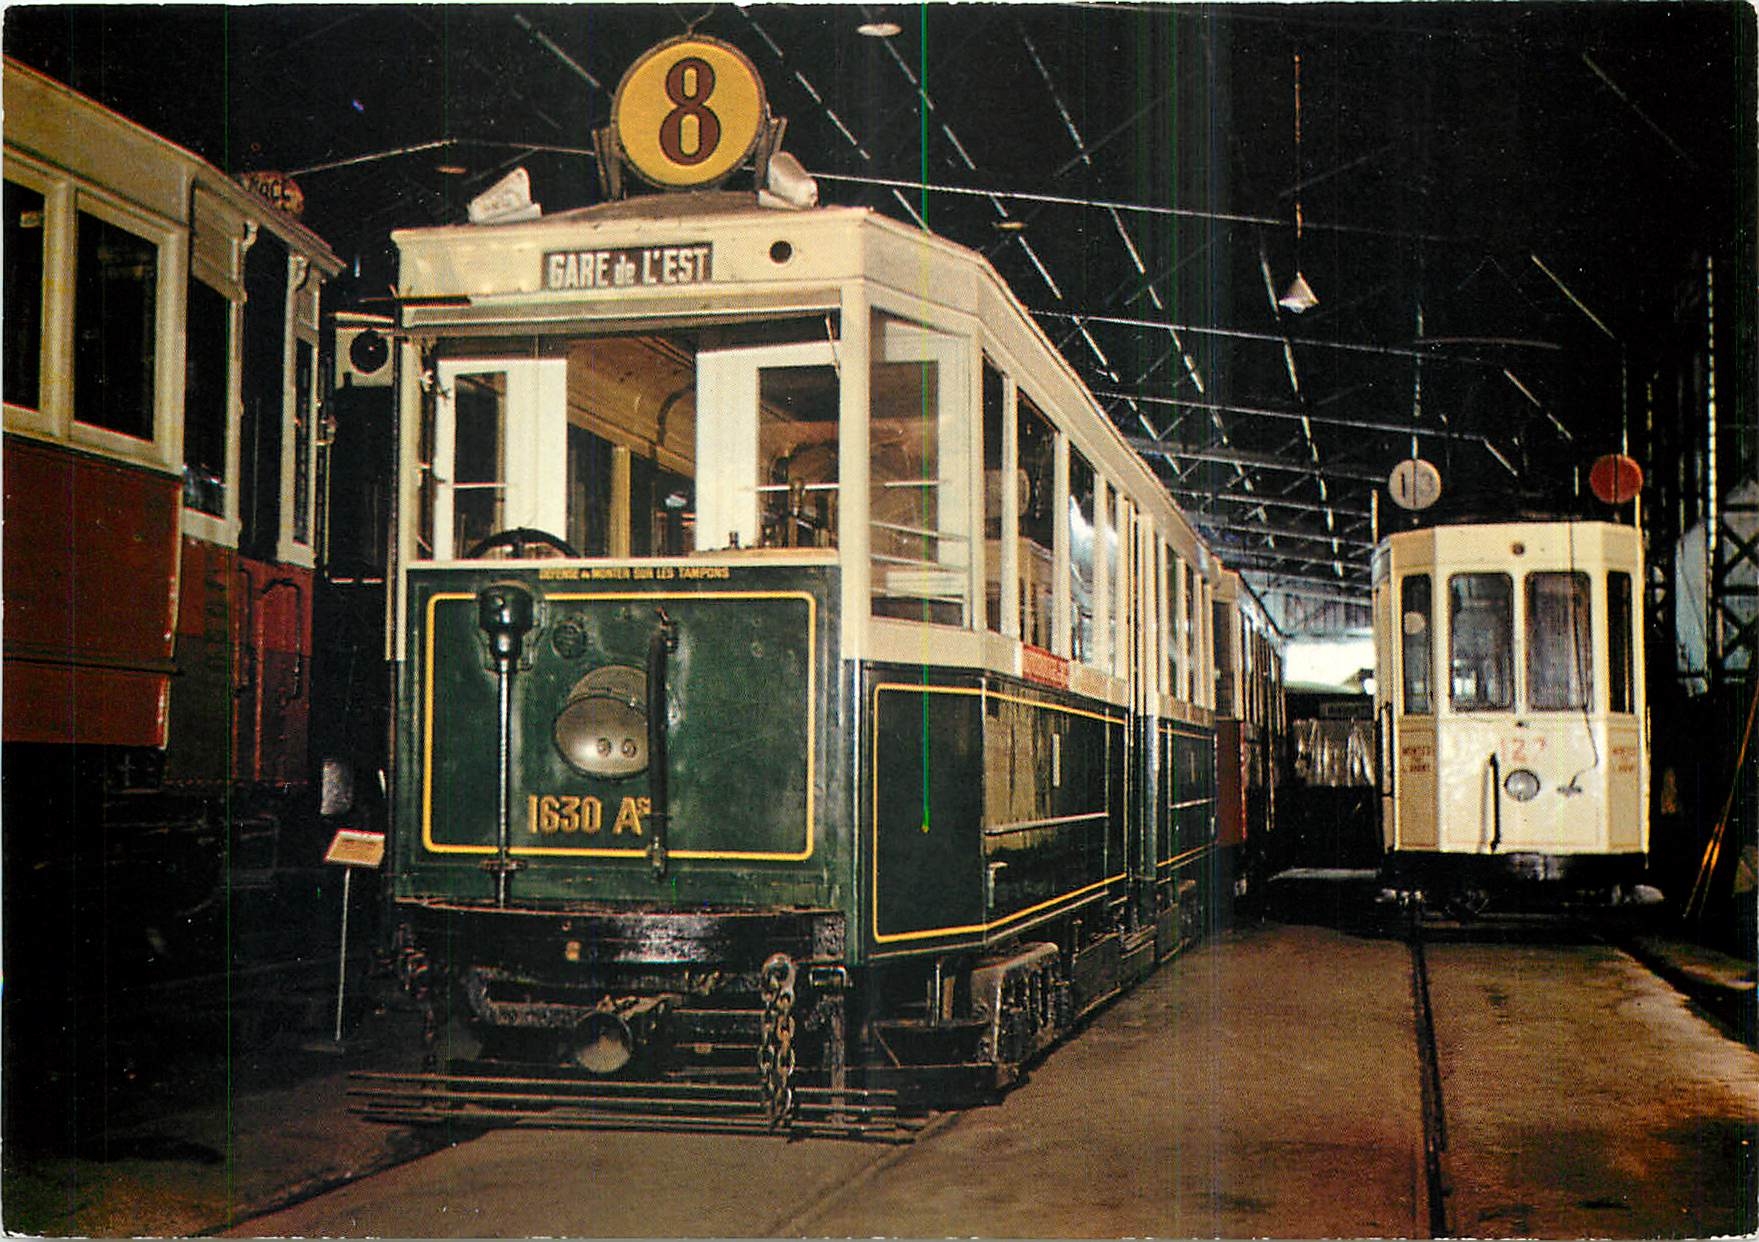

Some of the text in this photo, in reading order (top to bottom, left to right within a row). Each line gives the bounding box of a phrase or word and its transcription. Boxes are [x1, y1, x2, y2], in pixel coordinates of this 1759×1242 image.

[659, 56, 722, 166] 8
[549, 252, 611, 289] GARE
[641, 248, 710, 285] L'EST
[528, 794, 602, 835] 1630
